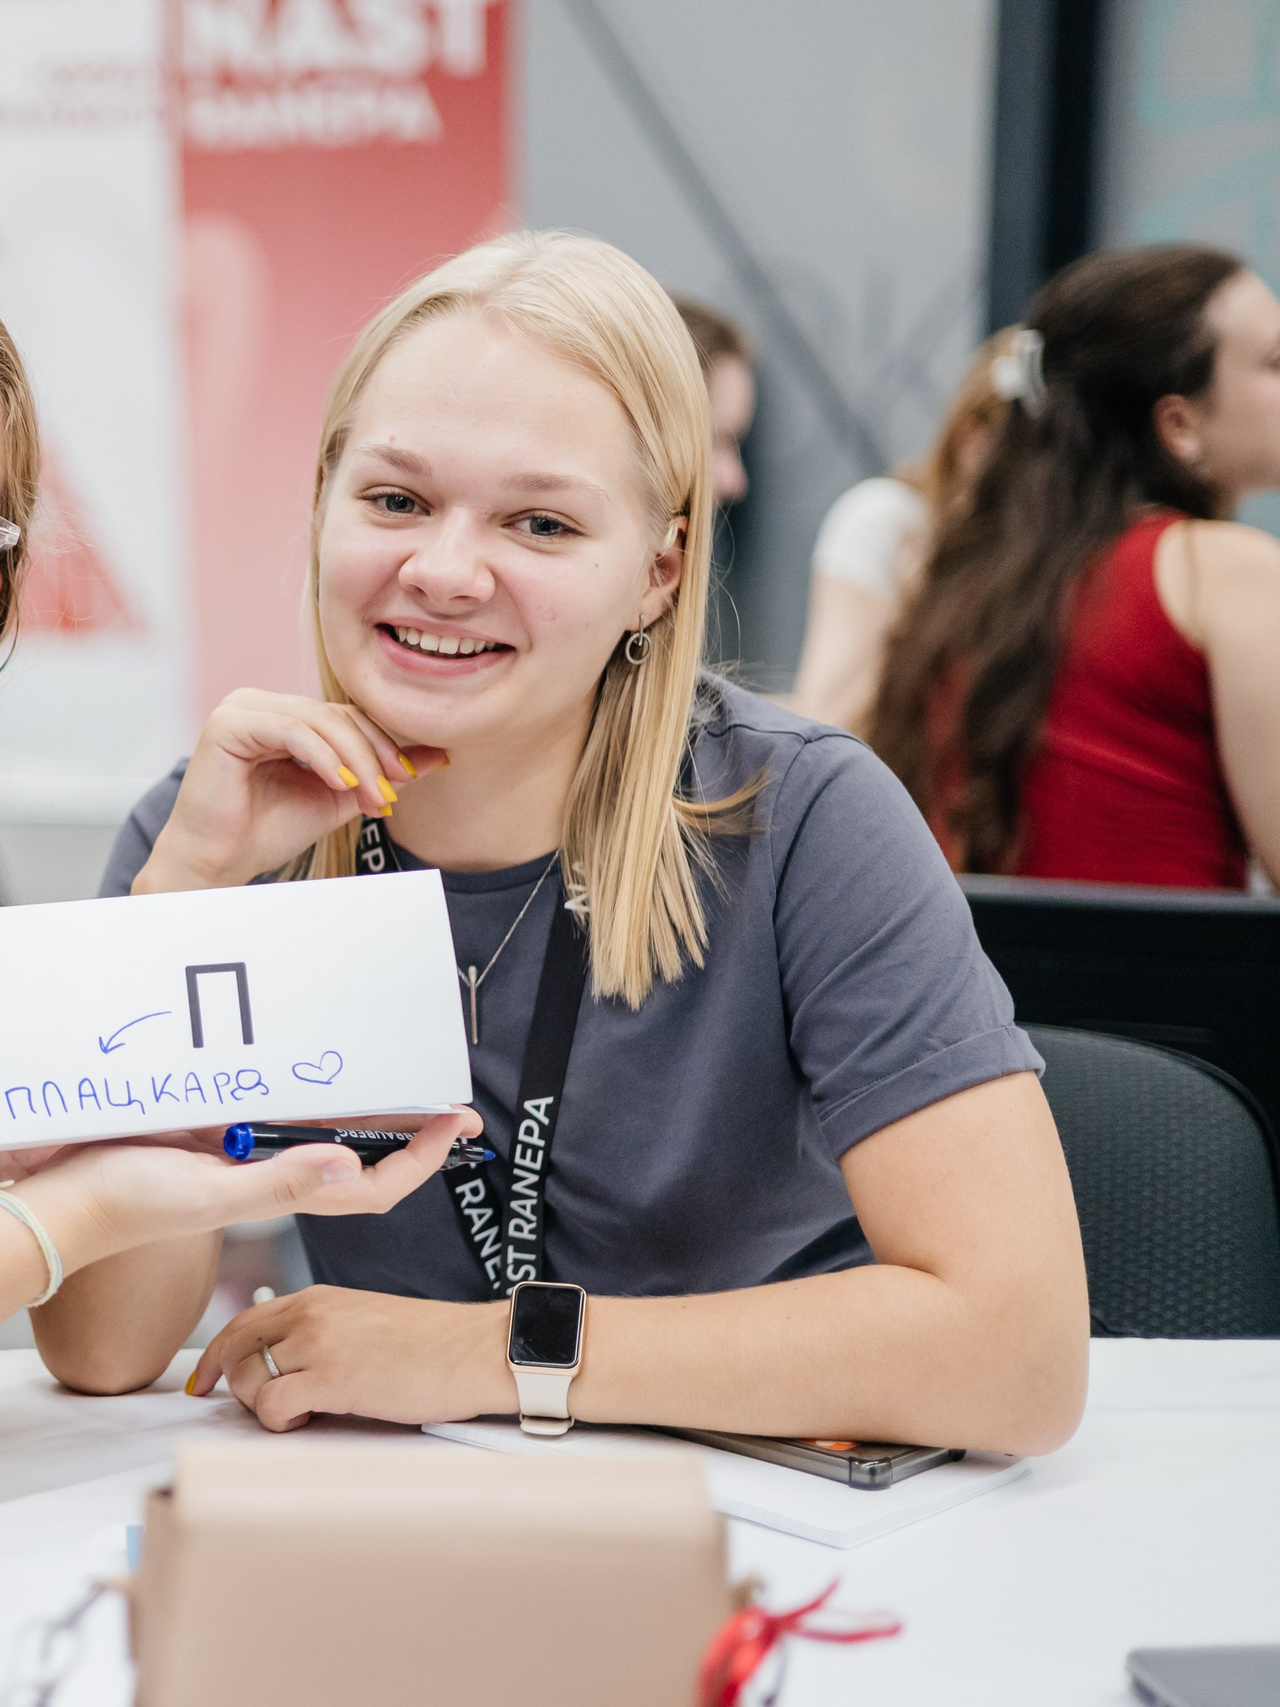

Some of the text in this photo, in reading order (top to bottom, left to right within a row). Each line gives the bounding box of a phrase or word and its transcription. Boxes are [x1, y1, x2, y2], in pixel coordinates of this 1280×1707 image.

[185, 962, 254, 1048] П
[508, 1095, 555, 1241] RANEPA
[455, 1178, 502, 1290] RANE
